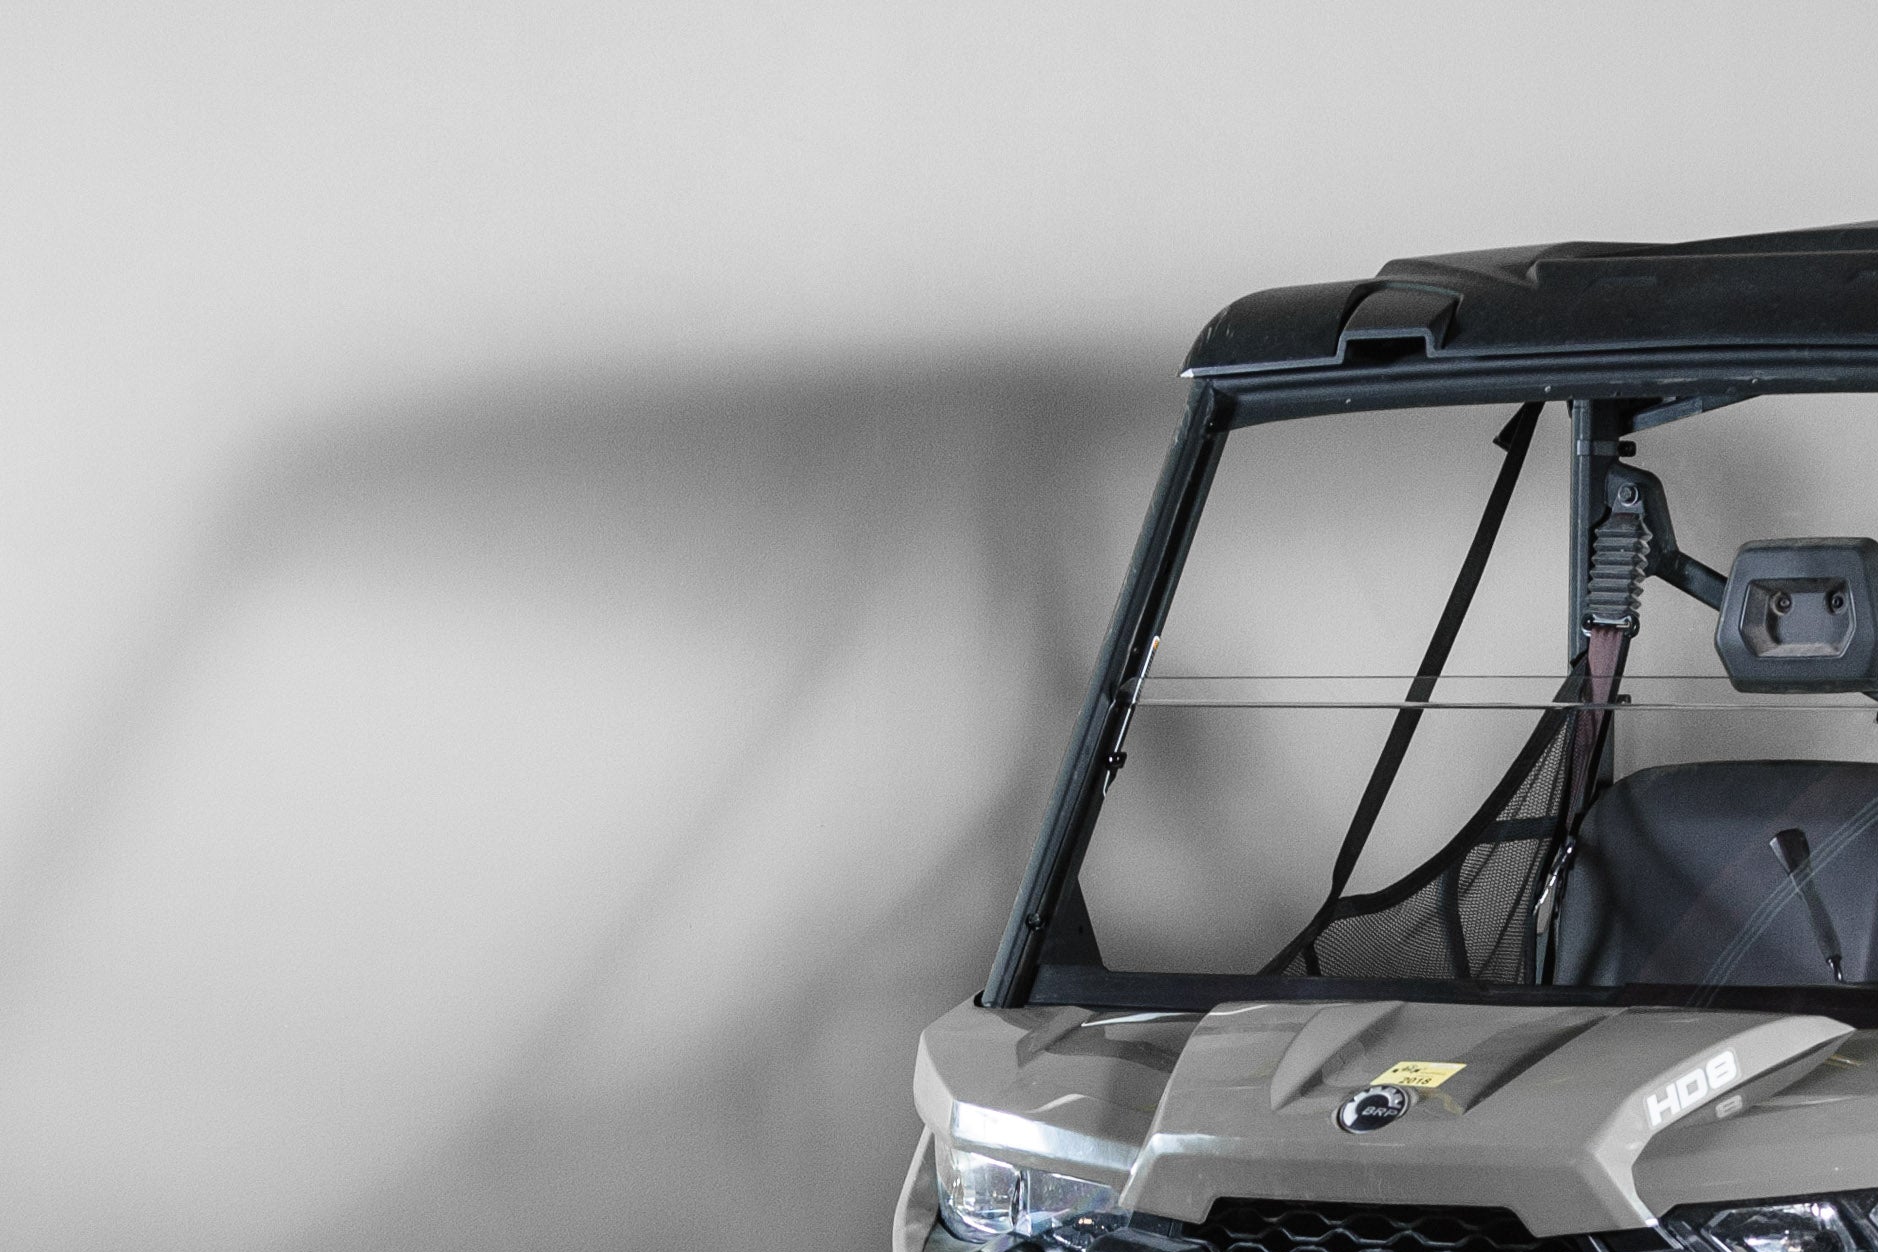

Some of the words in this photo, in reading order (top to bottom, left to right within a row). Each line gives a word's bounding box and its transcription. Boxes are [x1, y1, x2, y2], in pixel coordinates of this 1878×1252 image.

[1399, 1077, 1431, 1085] 2018
[1646, 1051, 1737, 1126] HD8
[1361, 1106, 1398, 1116] BRP
